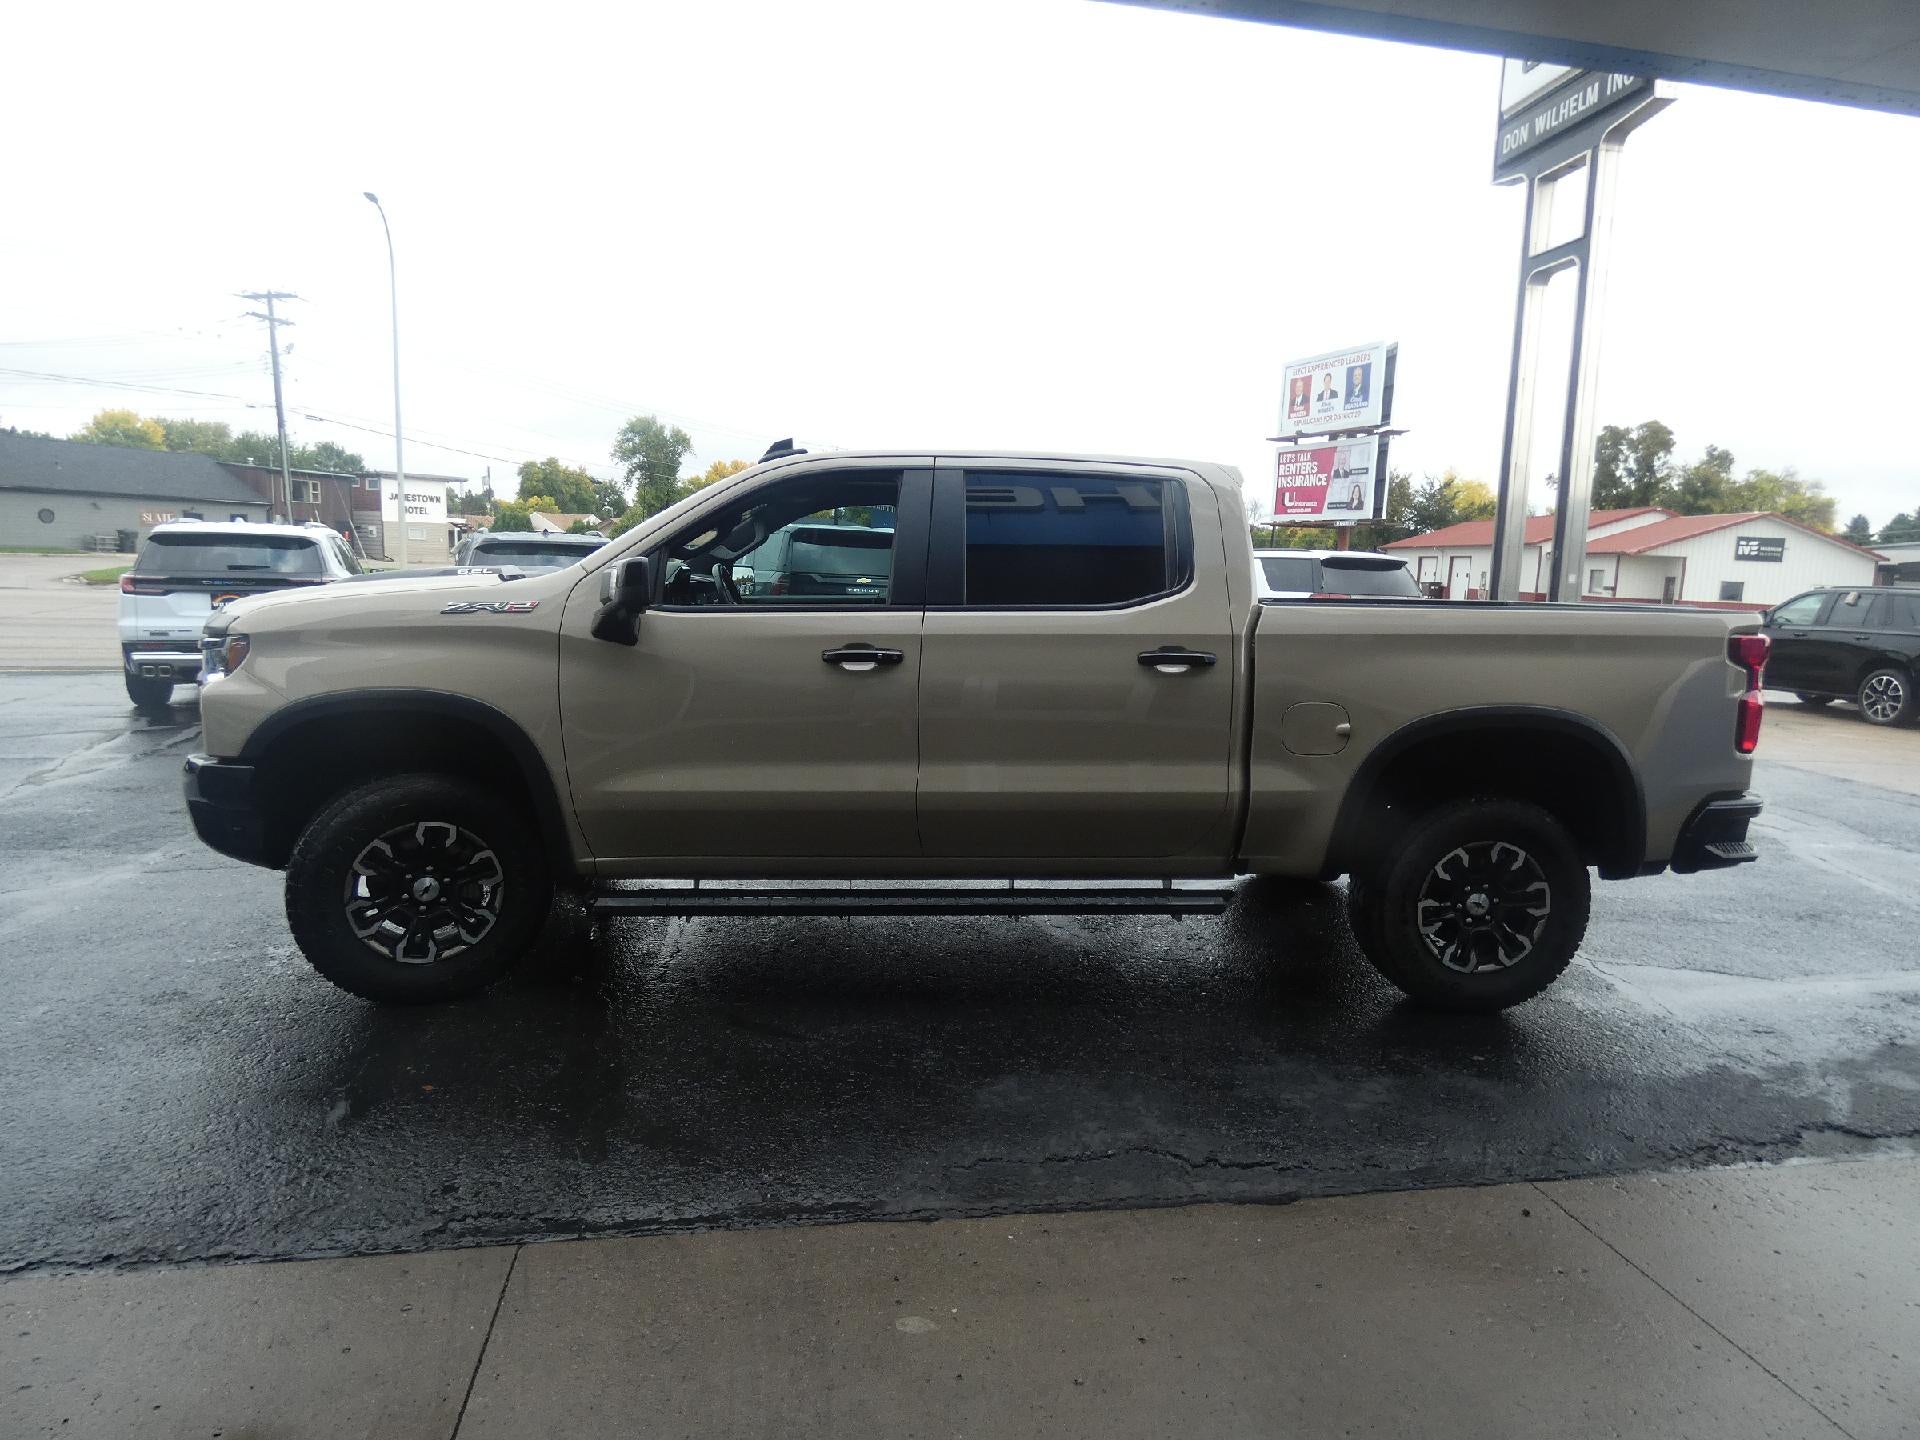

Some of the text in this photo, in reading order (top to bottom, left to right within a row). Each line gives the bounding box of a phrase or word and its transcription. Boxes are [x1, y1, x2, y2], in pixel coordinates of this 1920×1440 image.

[1502, 122, 1530, 155] DON
[1535, 82, 1599, 136] WILHELM
[1280, 452, 1312, 463] LET'S TALK
[1279, 461, 1318, 476] RENTERS
[1278, 473, 1328, 489] INSURANCE
[389, 493, 441, 504] JAESTOWN
[440, 601, 540, 614] ZR2
